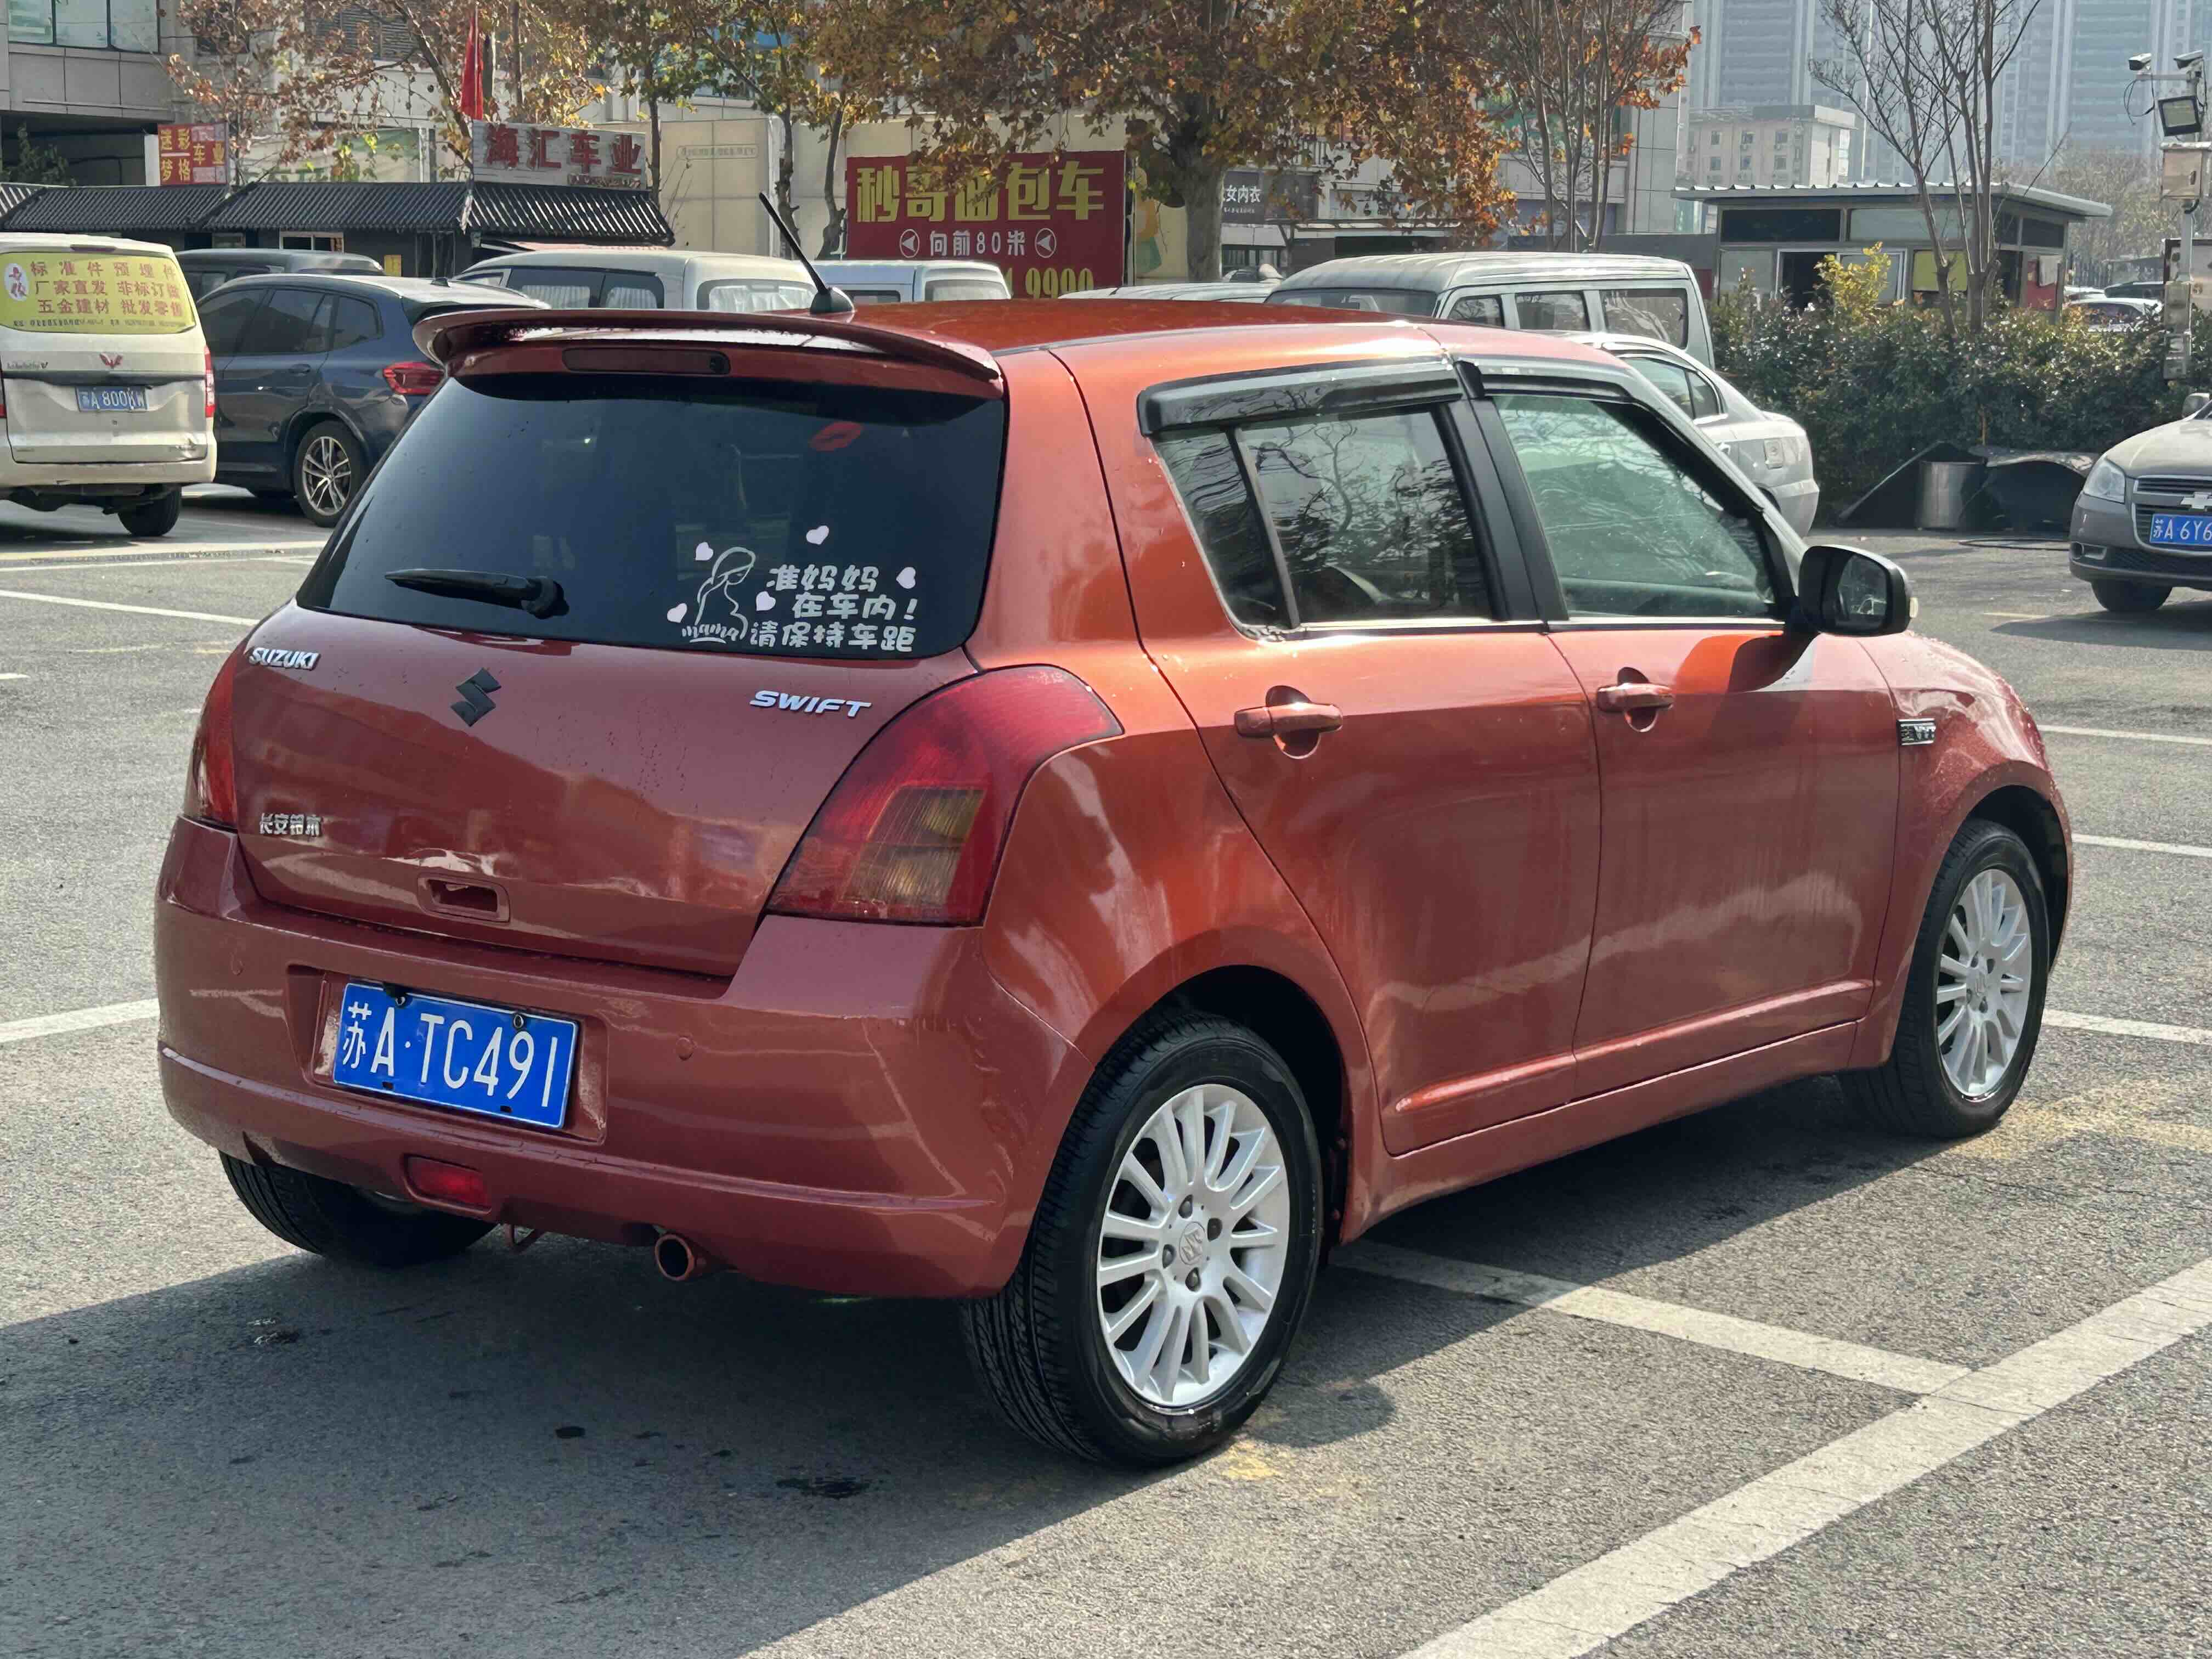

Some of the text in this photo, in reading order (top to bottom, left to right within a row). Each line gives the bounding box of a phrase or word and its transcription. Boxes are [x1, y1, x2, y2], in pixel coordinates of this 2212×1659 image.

[930, 230, 1025, 256] 向前80米
[35, 280, 108, 295] 厂家直发
[38, 299, 109, 313] 五金建材
[766, 565, 879, 591] 准妈妈
[751, 621, 916, 652] 请保持车距
[249, 647, 319, 669] SUZUKI
[749, 690, 872, 718] SWIFT
